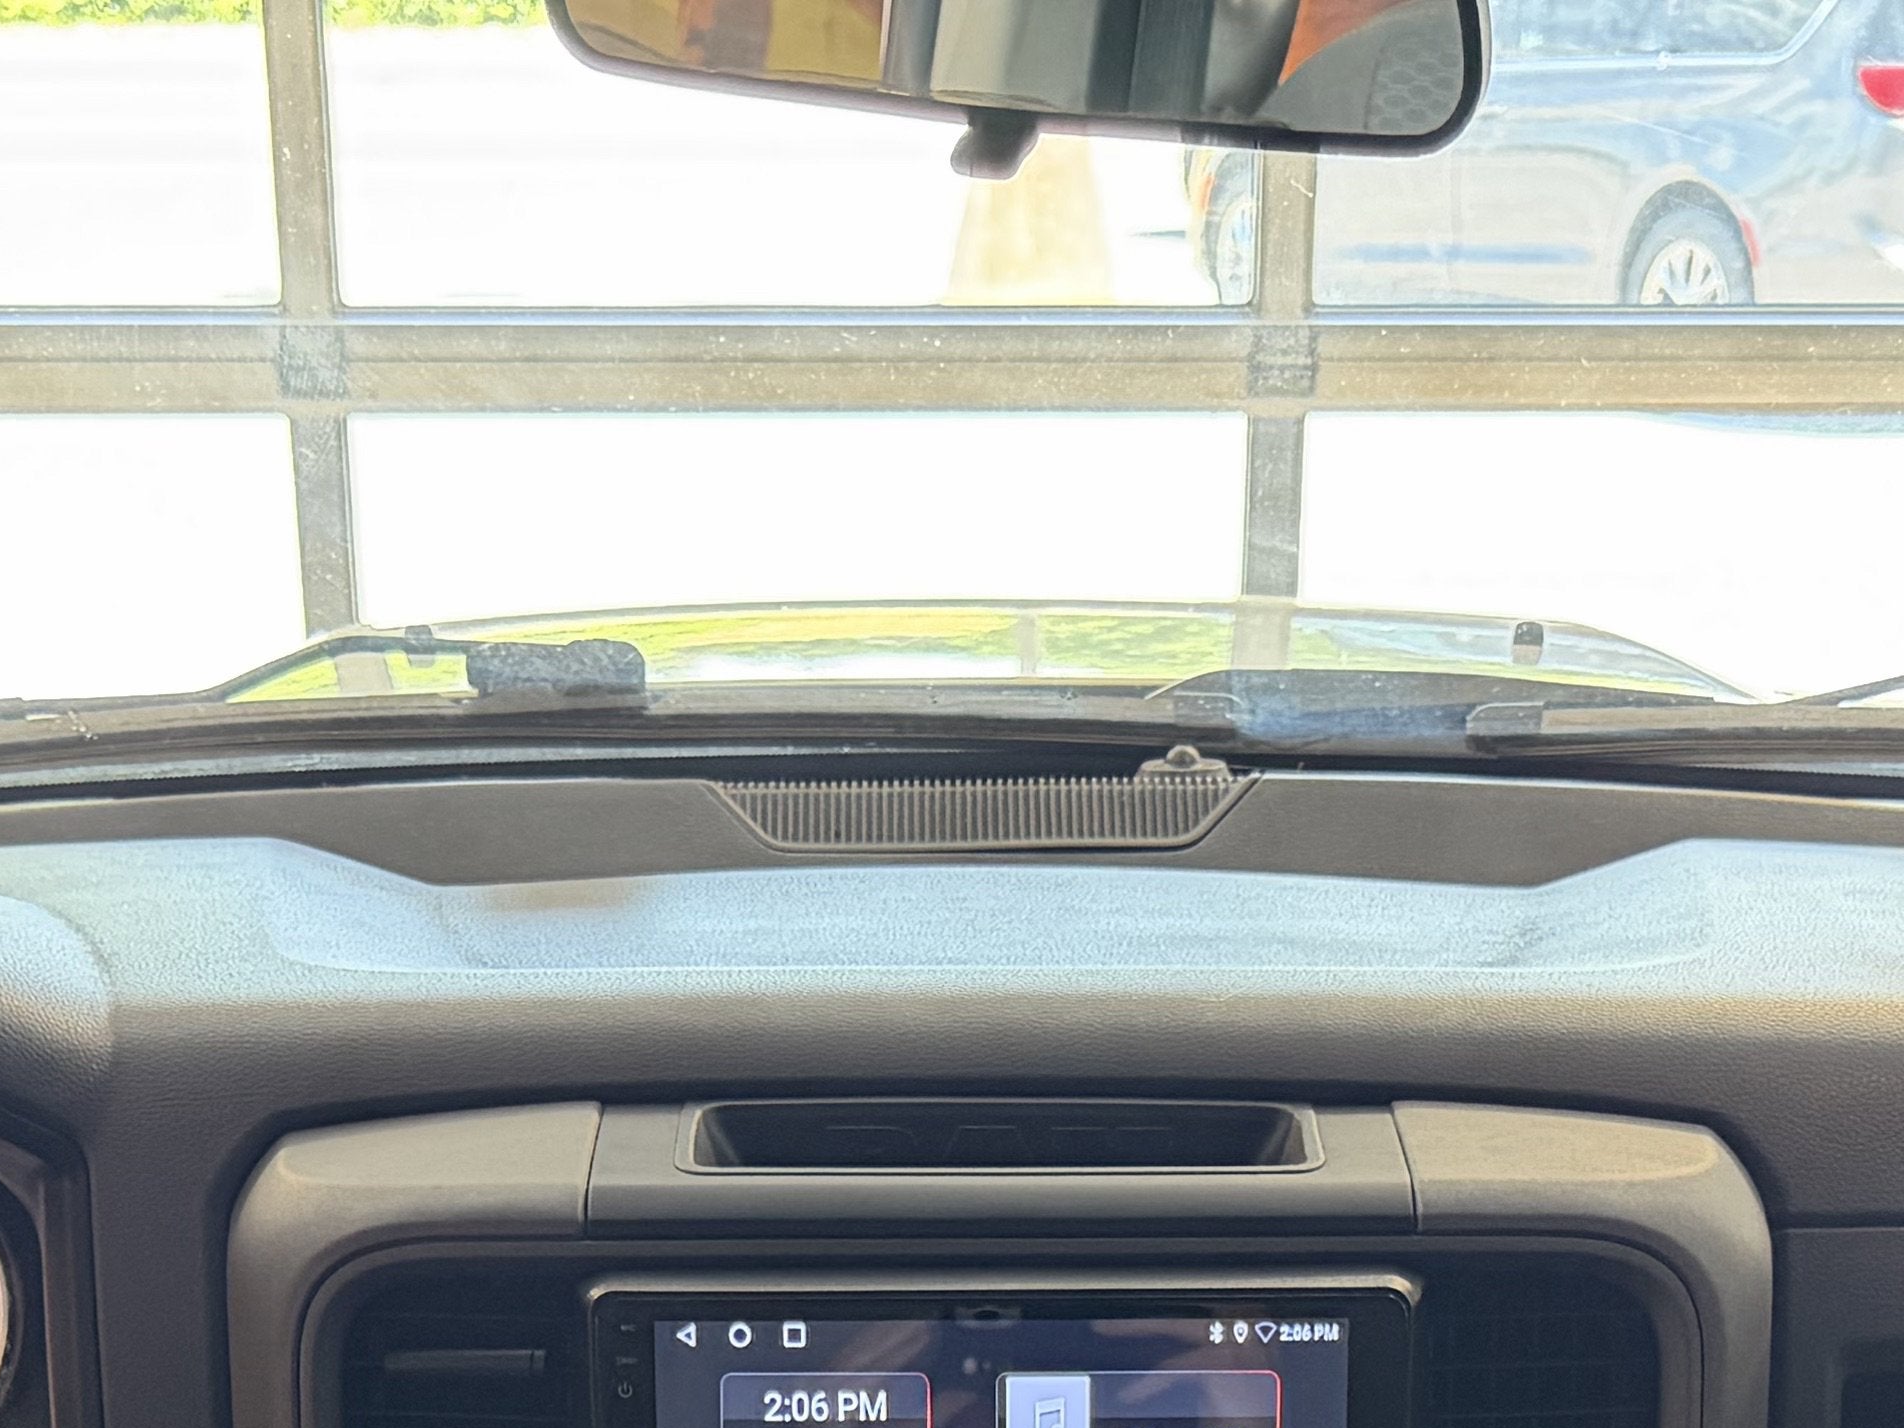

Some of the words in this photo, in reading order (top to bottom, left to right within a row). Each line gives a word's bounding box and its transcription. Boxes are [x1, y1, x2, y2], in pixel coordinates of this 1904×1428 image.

[1279, 1323, 1311, 1342] 2:06
[1313, 1323, 1340, 1342] PM
[762, 1389, 830, 1423] 2:06
[837, 1390, 888, 1422] PM
